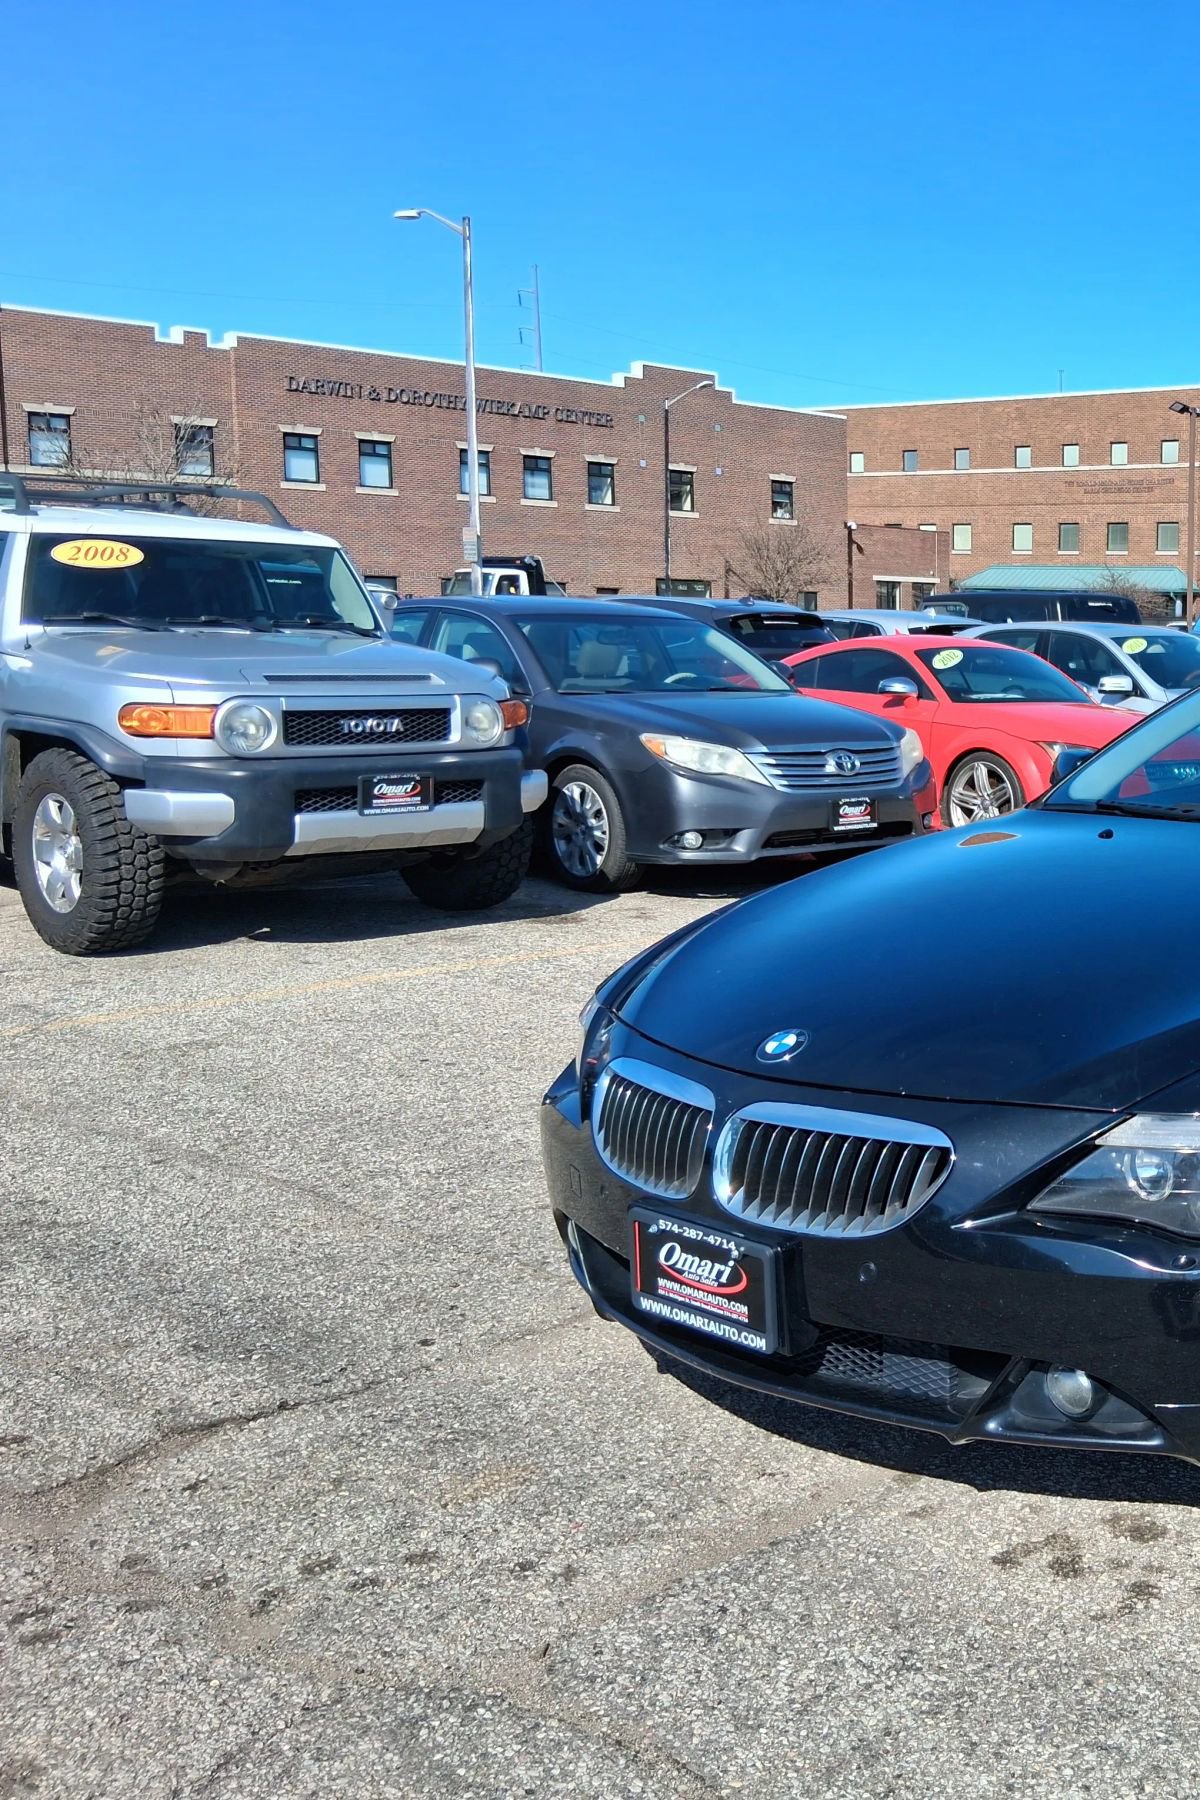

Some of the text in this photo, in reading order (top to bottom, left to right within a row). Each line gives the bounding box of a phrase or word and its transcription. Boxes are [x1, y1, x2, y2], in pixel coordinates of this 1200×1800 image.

[286, 376, 362, 399] DARWIN
[368, 386, 381, 401] &
[555, 407, 614, 428] CENTER
[67, 545, 130, 562] 2008
[340, 718, 404, 733] TOYOTA
[374, 781, 415, 796] Omari
[658, 1219, 736, 1251] 574-287-4714
[659, 1241, 735, 1284] Omari
[682, 1270, 719, 1288] Auto Sales
[657, 1277, 749, 1315] WWW.OMARIAUTO.COM
[640, 1297, 767, 1351] WWW.OMARIAUTO.COM
